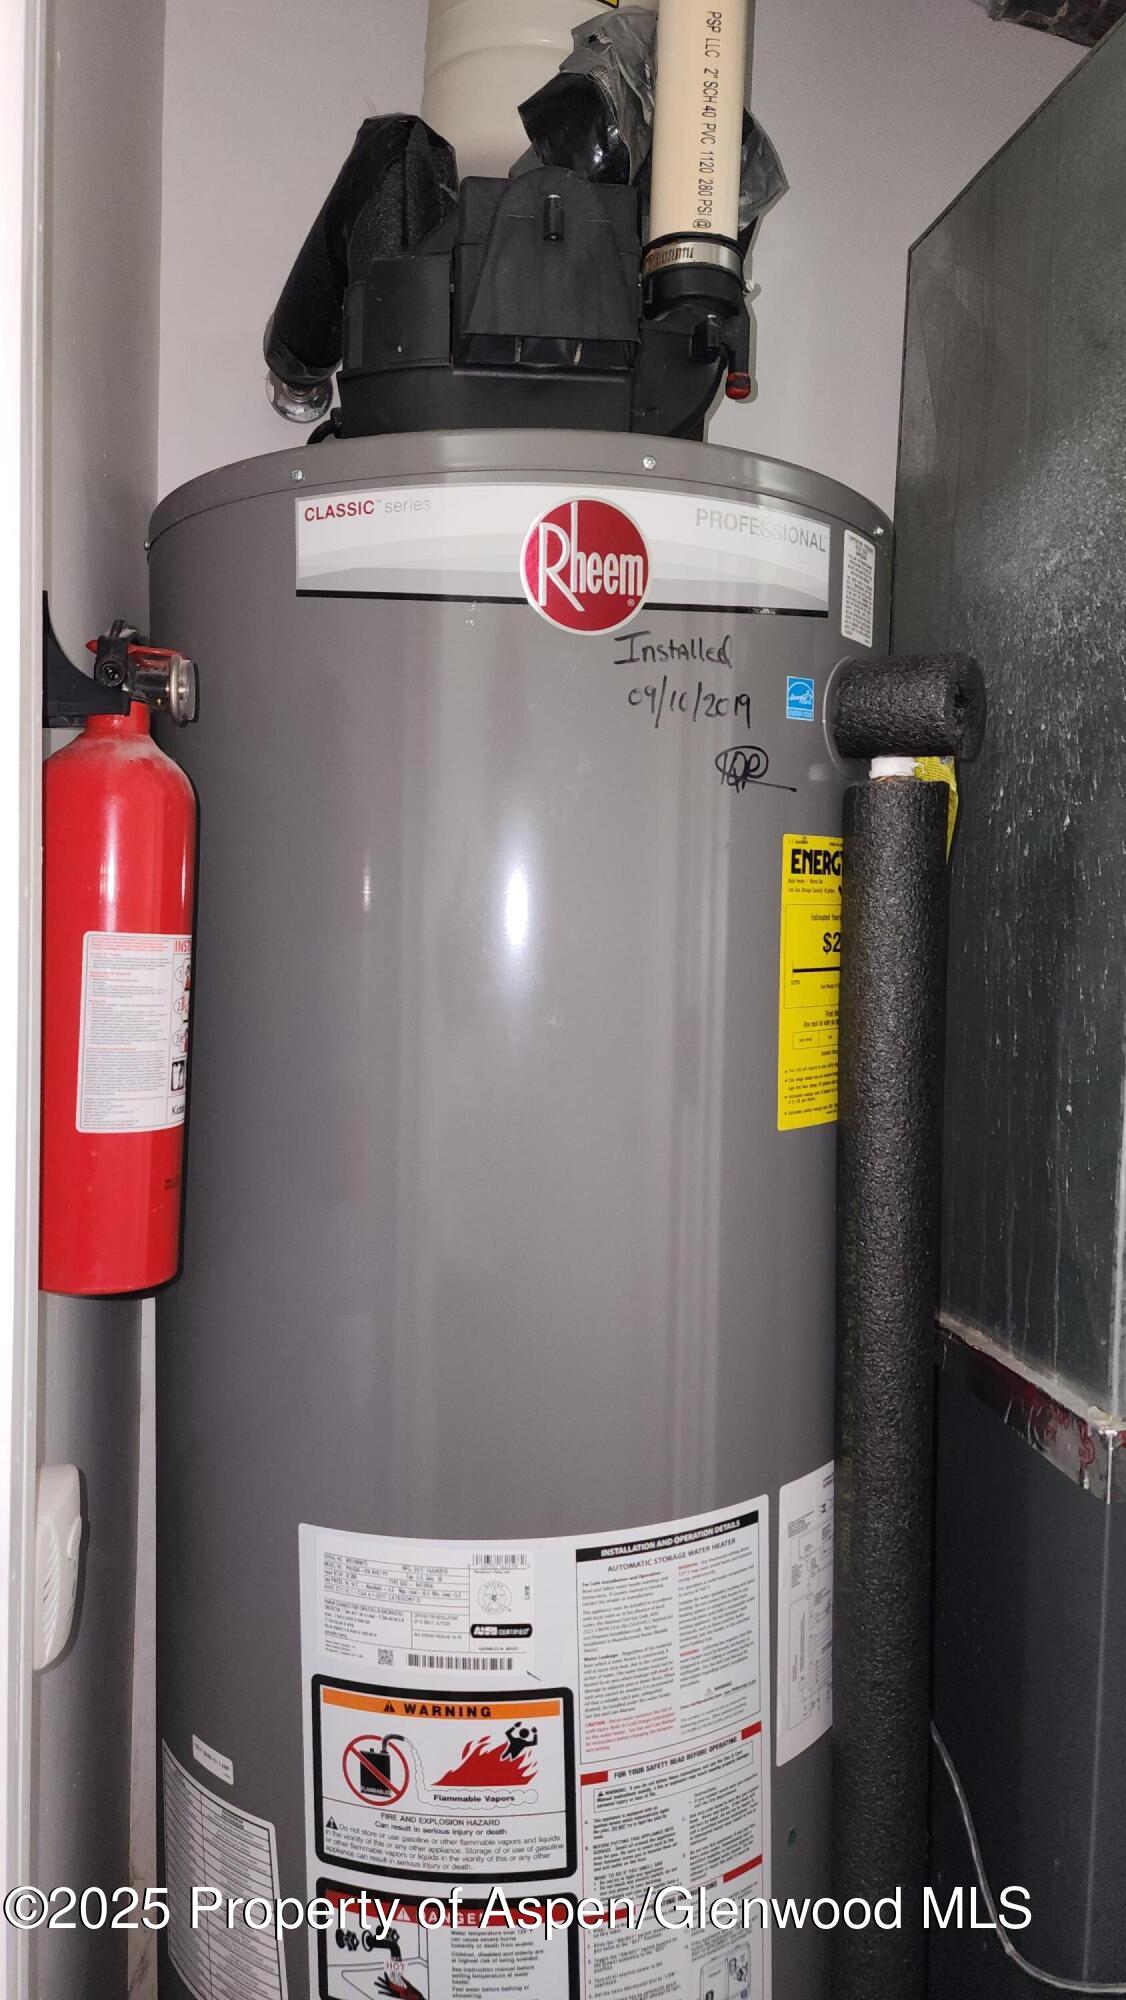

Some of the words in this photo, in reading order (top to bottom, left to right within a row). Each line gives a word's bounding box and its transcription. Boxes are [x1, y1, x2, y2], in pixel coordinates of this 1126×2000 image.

[706, 11, 722, 33] PSP
[705, 37, 720, 58] LLC
[703, 81, 719, 103] SCH
[702, 105, 717, 118] 40
[700, 123, 717, 145] PVC
[699, 151, 714, 174] 1120
[698, 178, 714, 197] 280
[697, 199, 713, 216] PSI
[693, 219, 712, 229] @
[385, 499, 432, 513] series
[613, 630, 733, 669] Installed
[791, 848, 842, 876] ENERG
[601, 1543, 656, 1557] INSTALLATION
[656, 1538, 674, 1548] AND
[674, 1528, 714, 1544] OPERATION
[714, 1520, 741, 1533] DETAILS
[608, 1558, 652, 1572] AUTOMATIC
[654, 1552, 686, 1565] STORAGE
[688, 1546, 711, 1557] WATER
[712, 1538, 736, 1551] HEATER
[404, 1703, 492, 1718] WARNING
[614, 1771, 626, 1779] FOR
[628, 1766, 644, 1776] YOUR
[646, 1760, 668, 1771] SAFETY
[670, 1755, 685, 1765] READ
[687, 1749, 707, 1761] BEFORE
[709, 1737, 737, 1753] OPERATING
[433, 1794, 482, 1802] Flammable
[485, 1795, 515, 1803] Vapors
[381, 1813, 397, 1821] FIRE
[419, 1817, 464, 1826] EXPLOSION
[391, 1823, 411, 1832] result
[452, 1828, 473, 1836] injury
[340, 1823, 348, 1831] Do
[361, 1829, 377, 1837] store
[402, 1835, 429, 1844] gasoline
[498, 1838, 522, 1846] vapors
[524, 1836, 536, 1844] and
[538, 1835, 560, 1843] liquids
[344, 1833, 364, 1844] vicinity
[395, 1842, 407, 1851] any
[409, 1844, 426, 1852] other
[465, 1847, 493, 1855] Storage
[536, 1844, 564, 1852] gasoline
[326, 1845, 355, 1857] appliance
[370, 1855, 387, 1863] result
[333, 1838, 348, 1847] other
[350, 1841, 383, 1855] flammable
[385, 1850, 407, 1859] vapors
[462, 1855, 484, 1863] vicinity
[533, 1852, 551, 1860] other
[417, 1908, 489, 1926] ANGE
[386, 1962, 405, 1972] HOT
